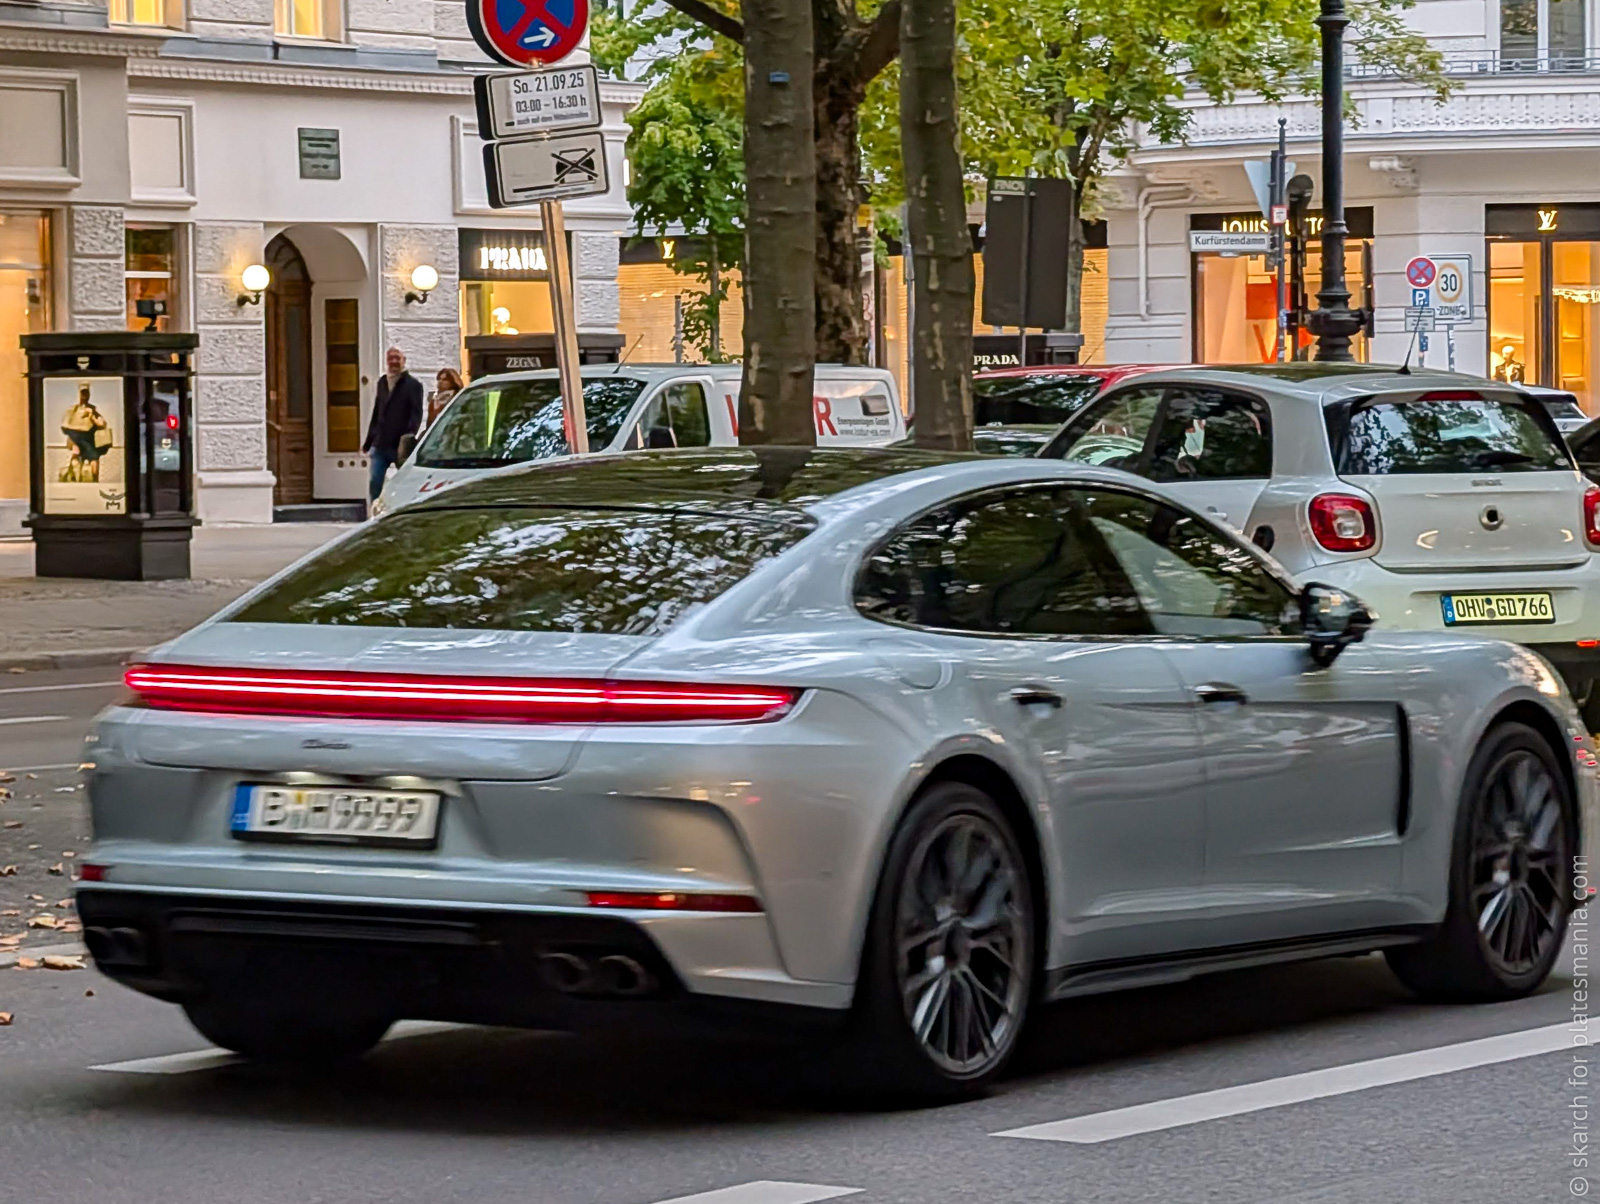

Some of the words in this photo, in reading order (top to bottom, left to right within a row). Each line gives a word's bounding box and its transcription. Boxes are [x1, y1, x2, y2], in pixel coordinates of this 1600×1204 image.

[513, 78, 532, 94] So.
[534, 71, 584, 92] 21.09.25
[515, 98, 542, 113] 03:00
[552, 94, 578, 110] 16:30
[580, 94, 587, 107] h
[1194, 235, 1266, 246] Kurfürstendamm
[480, 246, 548, 271] PRADA
[1440, 273, 1458, 292] 30
[1438, 305, 1462, 316] ZONE
[973, 354, 1020, 366] PRADA
[1455, 598, 1486, 618] OHV
